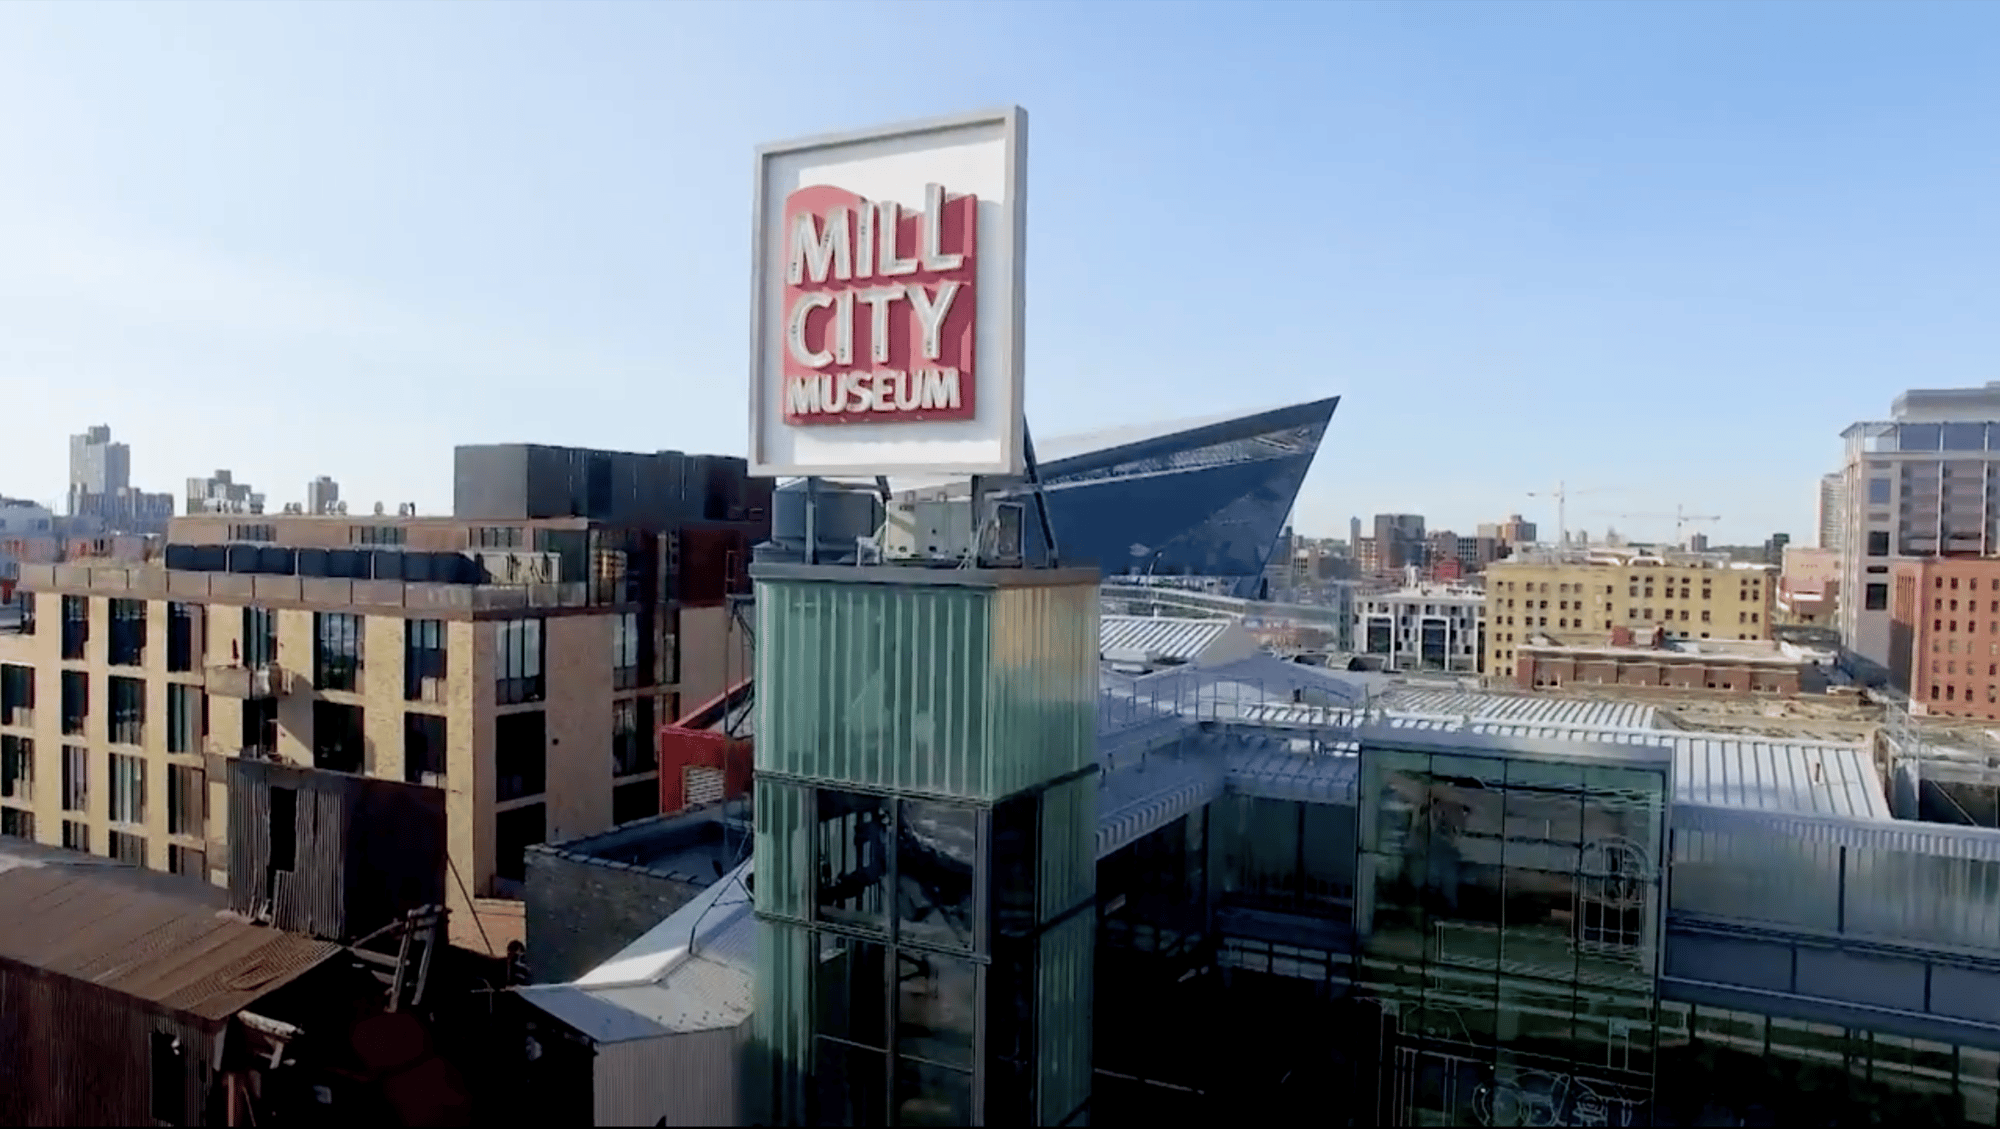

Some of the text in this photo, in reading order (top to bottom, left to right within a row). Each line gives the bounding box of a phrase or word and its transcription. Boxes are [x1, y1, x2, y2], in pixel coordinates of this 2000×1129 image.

[787, 182, 964, 286] MILL
[788, 281, 960, 367] CITY
[786, 367, 961, 415] MUSEUM
